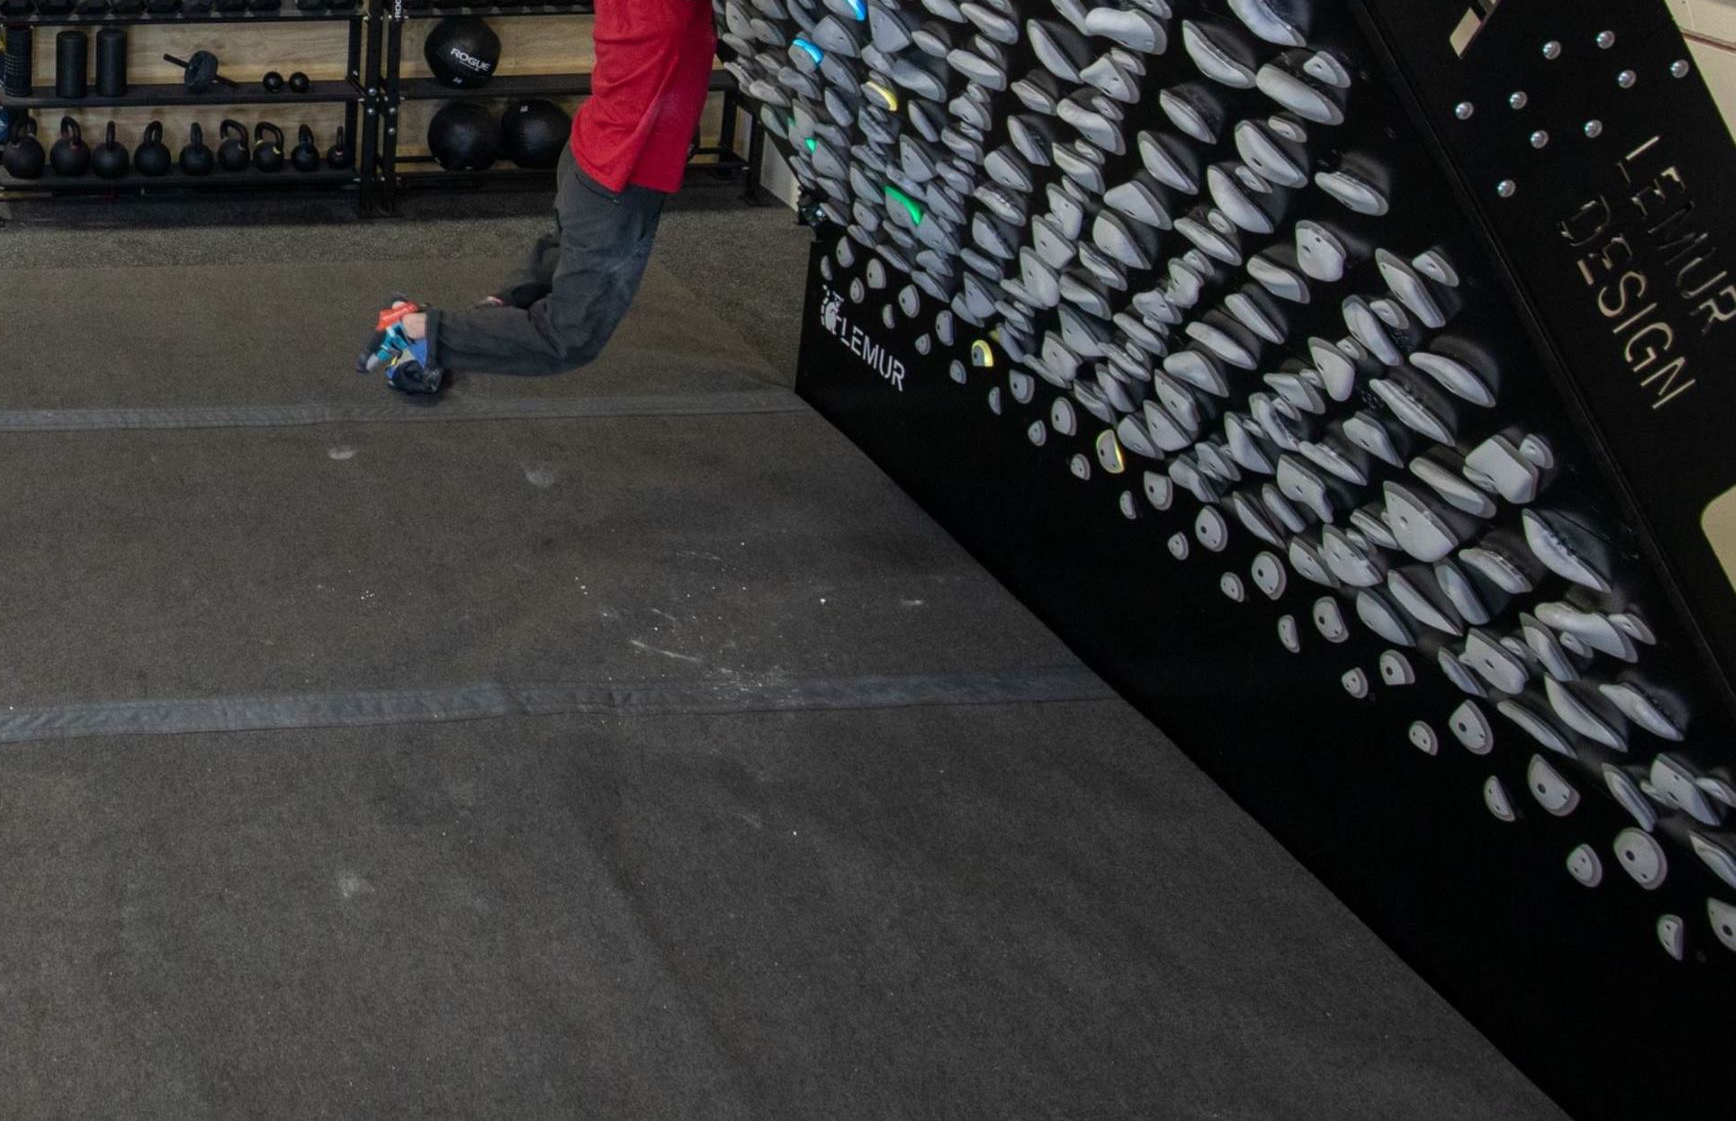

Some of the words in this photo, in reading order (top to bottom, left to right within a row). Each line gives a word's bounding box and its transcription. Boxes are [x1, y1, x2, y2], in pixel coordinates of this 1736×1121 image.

[450, 47, 491, 71] ROGUE
[1556, 194, 1696, 409] DESIGN
[841, 317, 905, 392] LEMUR
